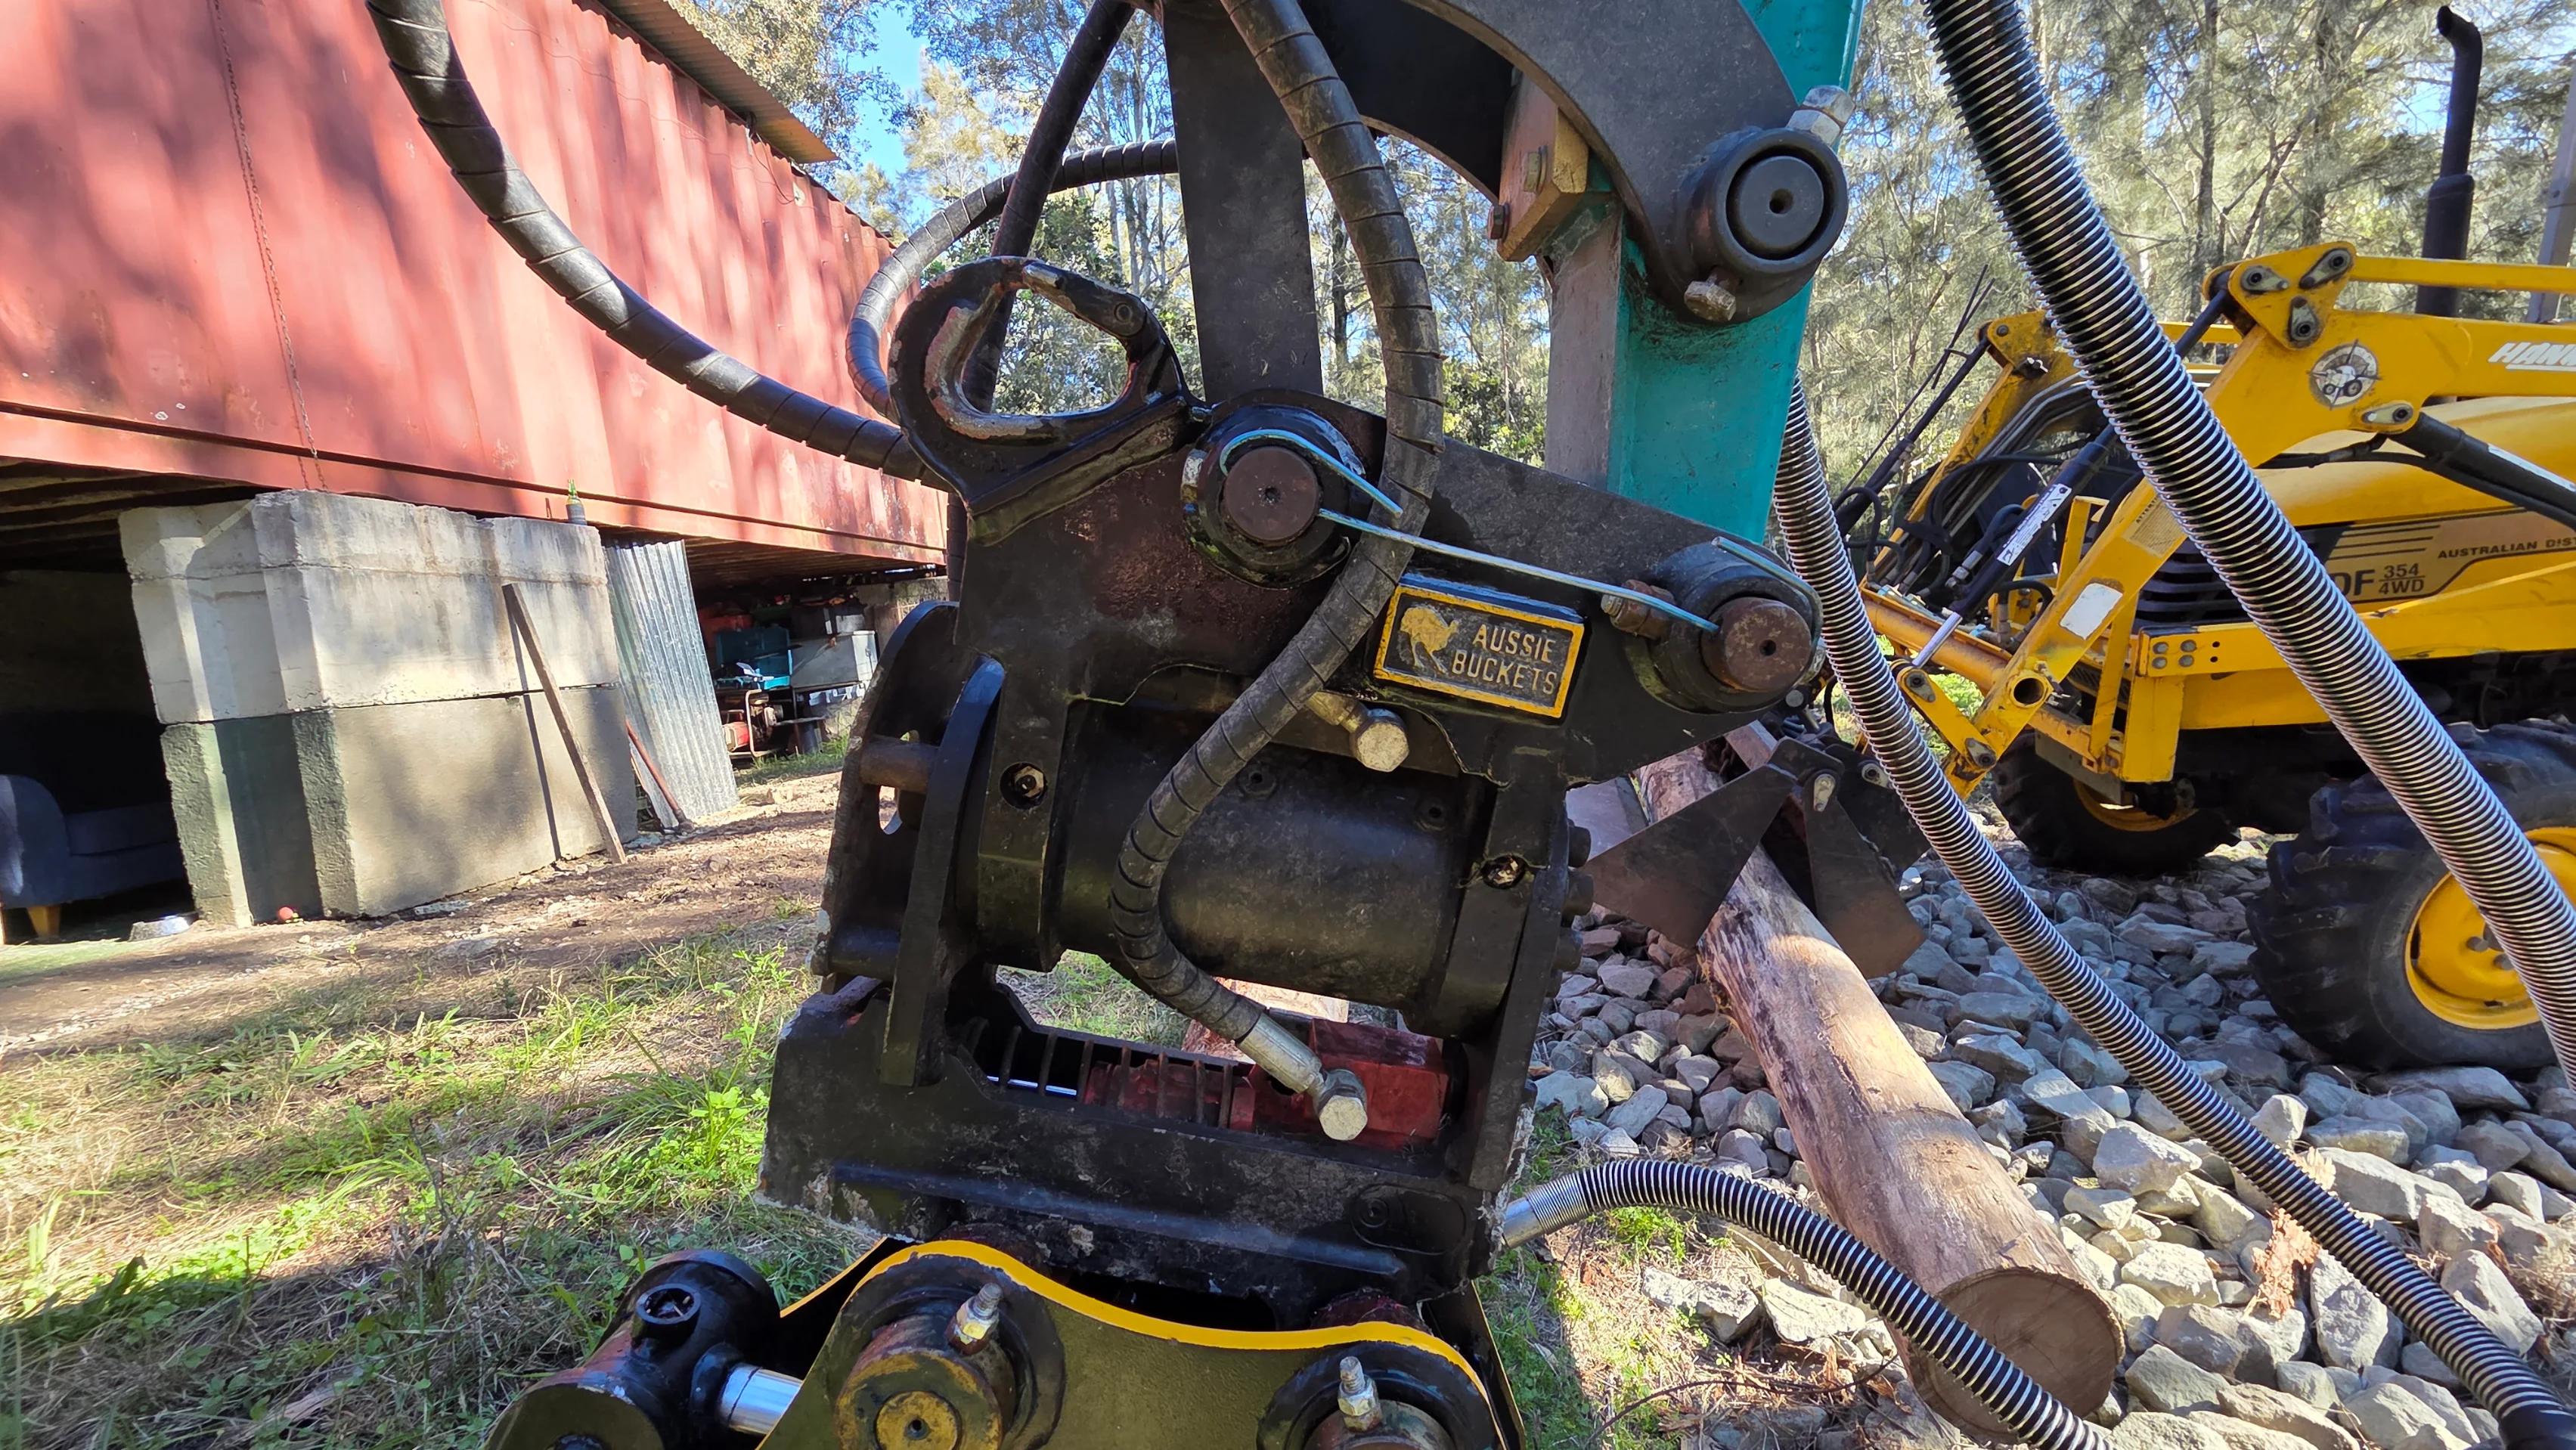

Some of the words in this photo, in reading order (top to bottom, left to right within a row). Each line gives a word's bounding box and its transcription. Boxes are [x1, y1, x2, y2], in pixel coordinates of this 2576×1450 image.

[2136, 495, 2159, 523] ATTENTI
[2438, 541, 2537, 559] AUSTRALIAN
[2383, 562, 2419, 579] 354
[2379, 578, 2424, 595] 4WD
[1472, 624, 1556, 664] AUSSIE
[1452, 649, 1558, 695] BUCKETS
